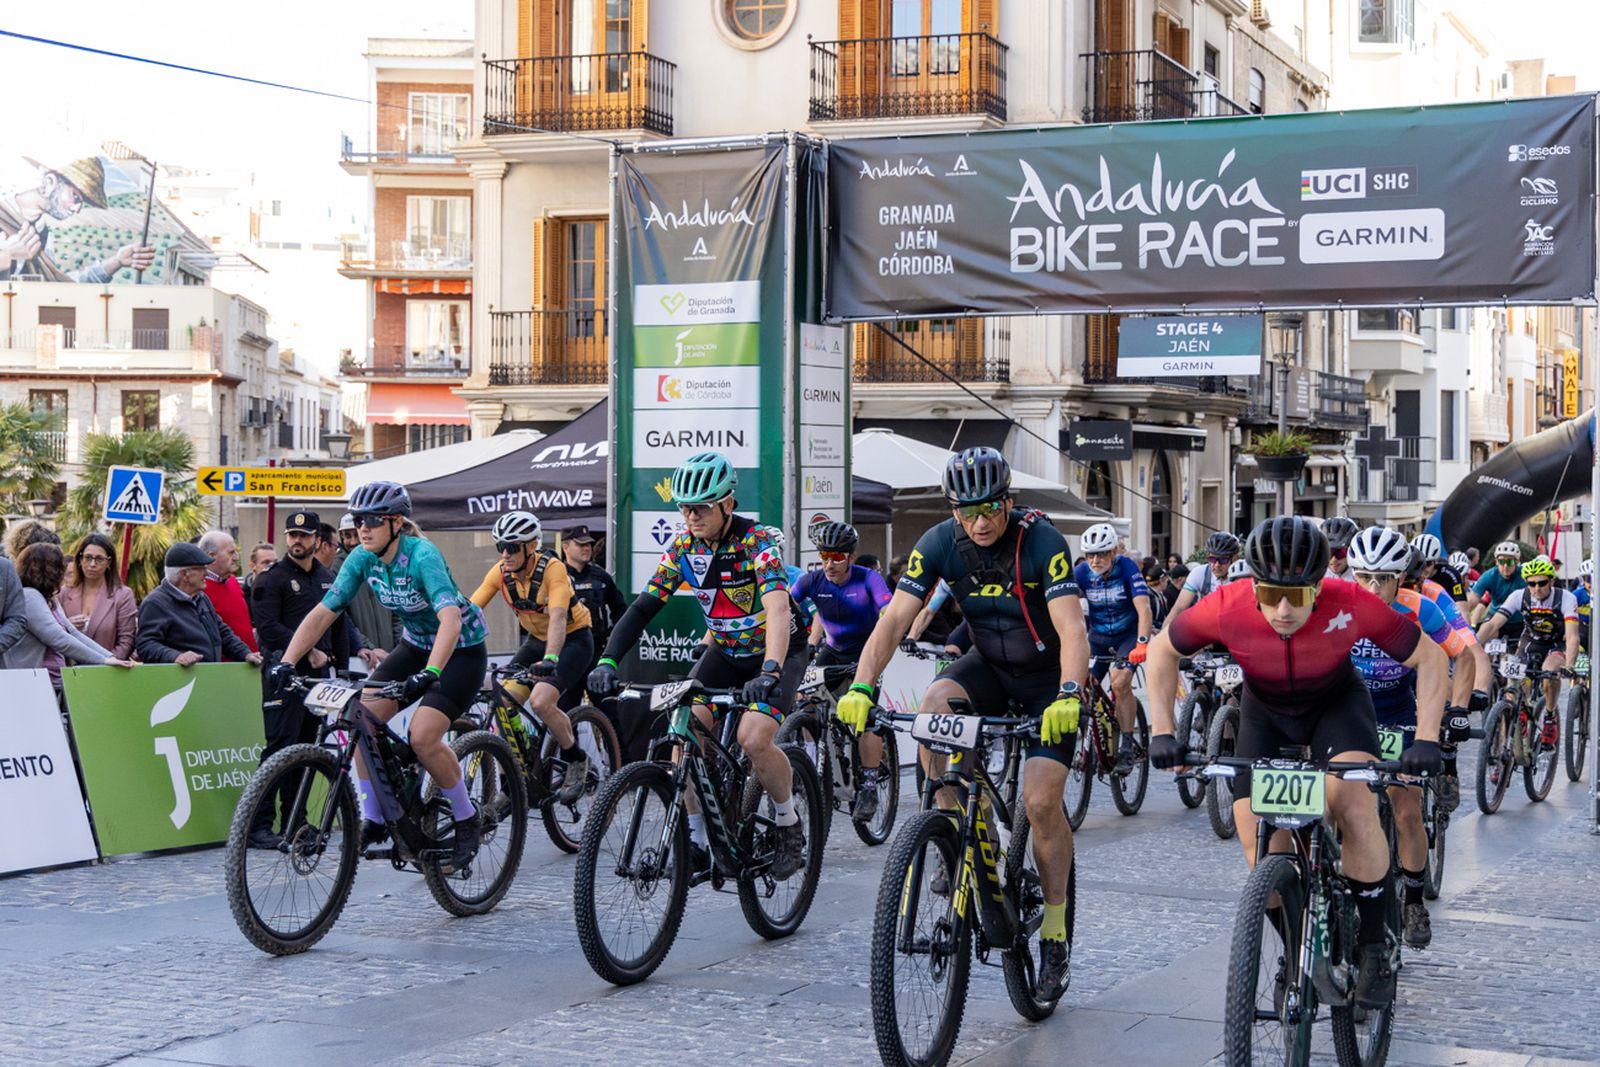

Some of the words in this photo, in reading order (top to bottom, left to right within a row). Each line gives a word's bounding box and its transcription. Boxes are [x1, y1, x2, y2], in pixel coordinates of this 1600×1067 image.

[1528, 145, 1571, 156] esedos
[858, 157, 935, 180] Andalucía
[1006, 147, 1285, 224] Andalucía
[1312, 173, 1361, 195] UCI
[1372, 172, 1409, 191] SHC
[1520, 197, 1558, 206] CICLISMO
[645, 197, 755, 231] Andalucía
[879, 203, 955, 226] GRANADA
[895, 226, 938, 250] JAÉN
[1316, 225, 1428, 247] GARMIN
[1010, 223, 1123, 273] BIKE
[1138, 217, 1286, 270] RACE
[879, 252, 954, 276] CÓRDOBA
[688, 296, 733, 307] Diputación
[687, 308, 698, 316] de
[700, 306, 736, 315] Granada
[1156, 322, 1209, 336] STAGE
[1211, 321, 1224, 335] 4
[1168, 338, 1211, 353] JAÉN
[1162, 361, 1214, 371] GARMIN
[686, 379, 731, 389] Diputación
[685, 391, 696, 399] de
[697, 390, 732, 399] Córdoba
[803, 388, 840, 403] GARMIN
[645, 430, 745, 448] GARMIN
[251, 472, 302, 480] aparcamiento
[250, 482, 274, 491] San
[281, 482, 342, 492] Francisco
[1477, 475, 1534, 496] garmin.com
[639, 646, 668, 662] BIKE
[670, 647, 698, 662] RAC
[1222, 668, 1239, 681] 878
[1364, 679, 1400, 689] EDIDA
[317, 685, 346, 702] 810
[928, 714, 966, 739] 856
[185, 743, 267, 768] DIPUTACIÓ
[0, 754, 54, 779] ENTO
[191, 773, 215, 791] DE
[216, 767, 252, 789] JAÉN
[1261, 773, 1317, 806] 2207
